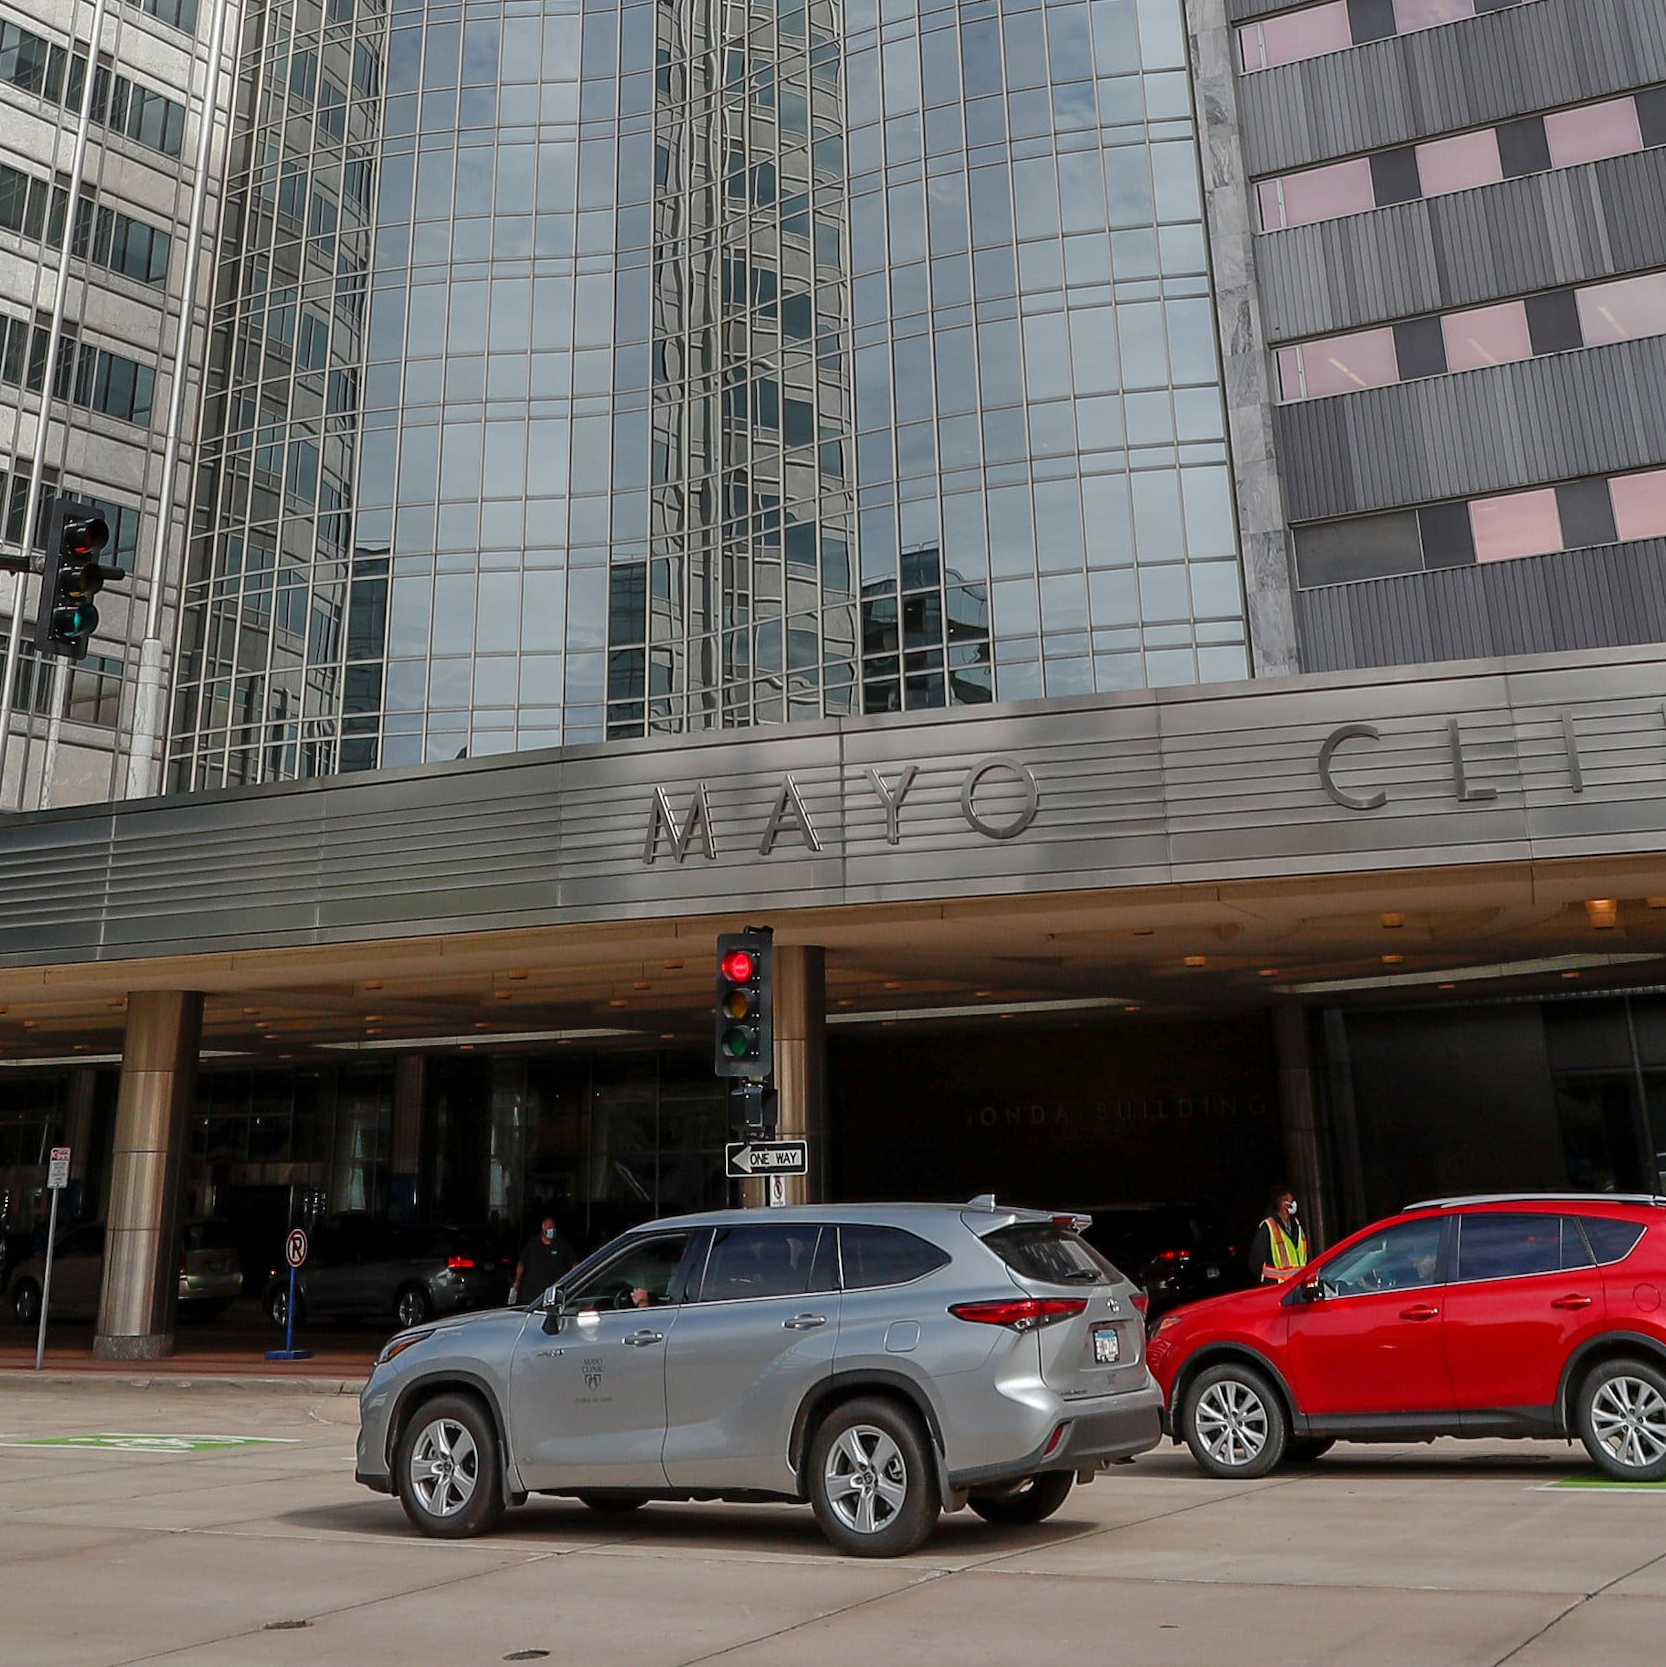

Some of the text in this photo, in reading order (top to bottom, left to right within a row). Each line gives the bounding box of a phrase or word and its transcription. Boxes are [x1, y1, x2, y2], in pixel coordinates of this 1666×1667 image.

[642, 756, 1040, 865] MAYO
[750, 1151, 797, 1165] ONE WAY
